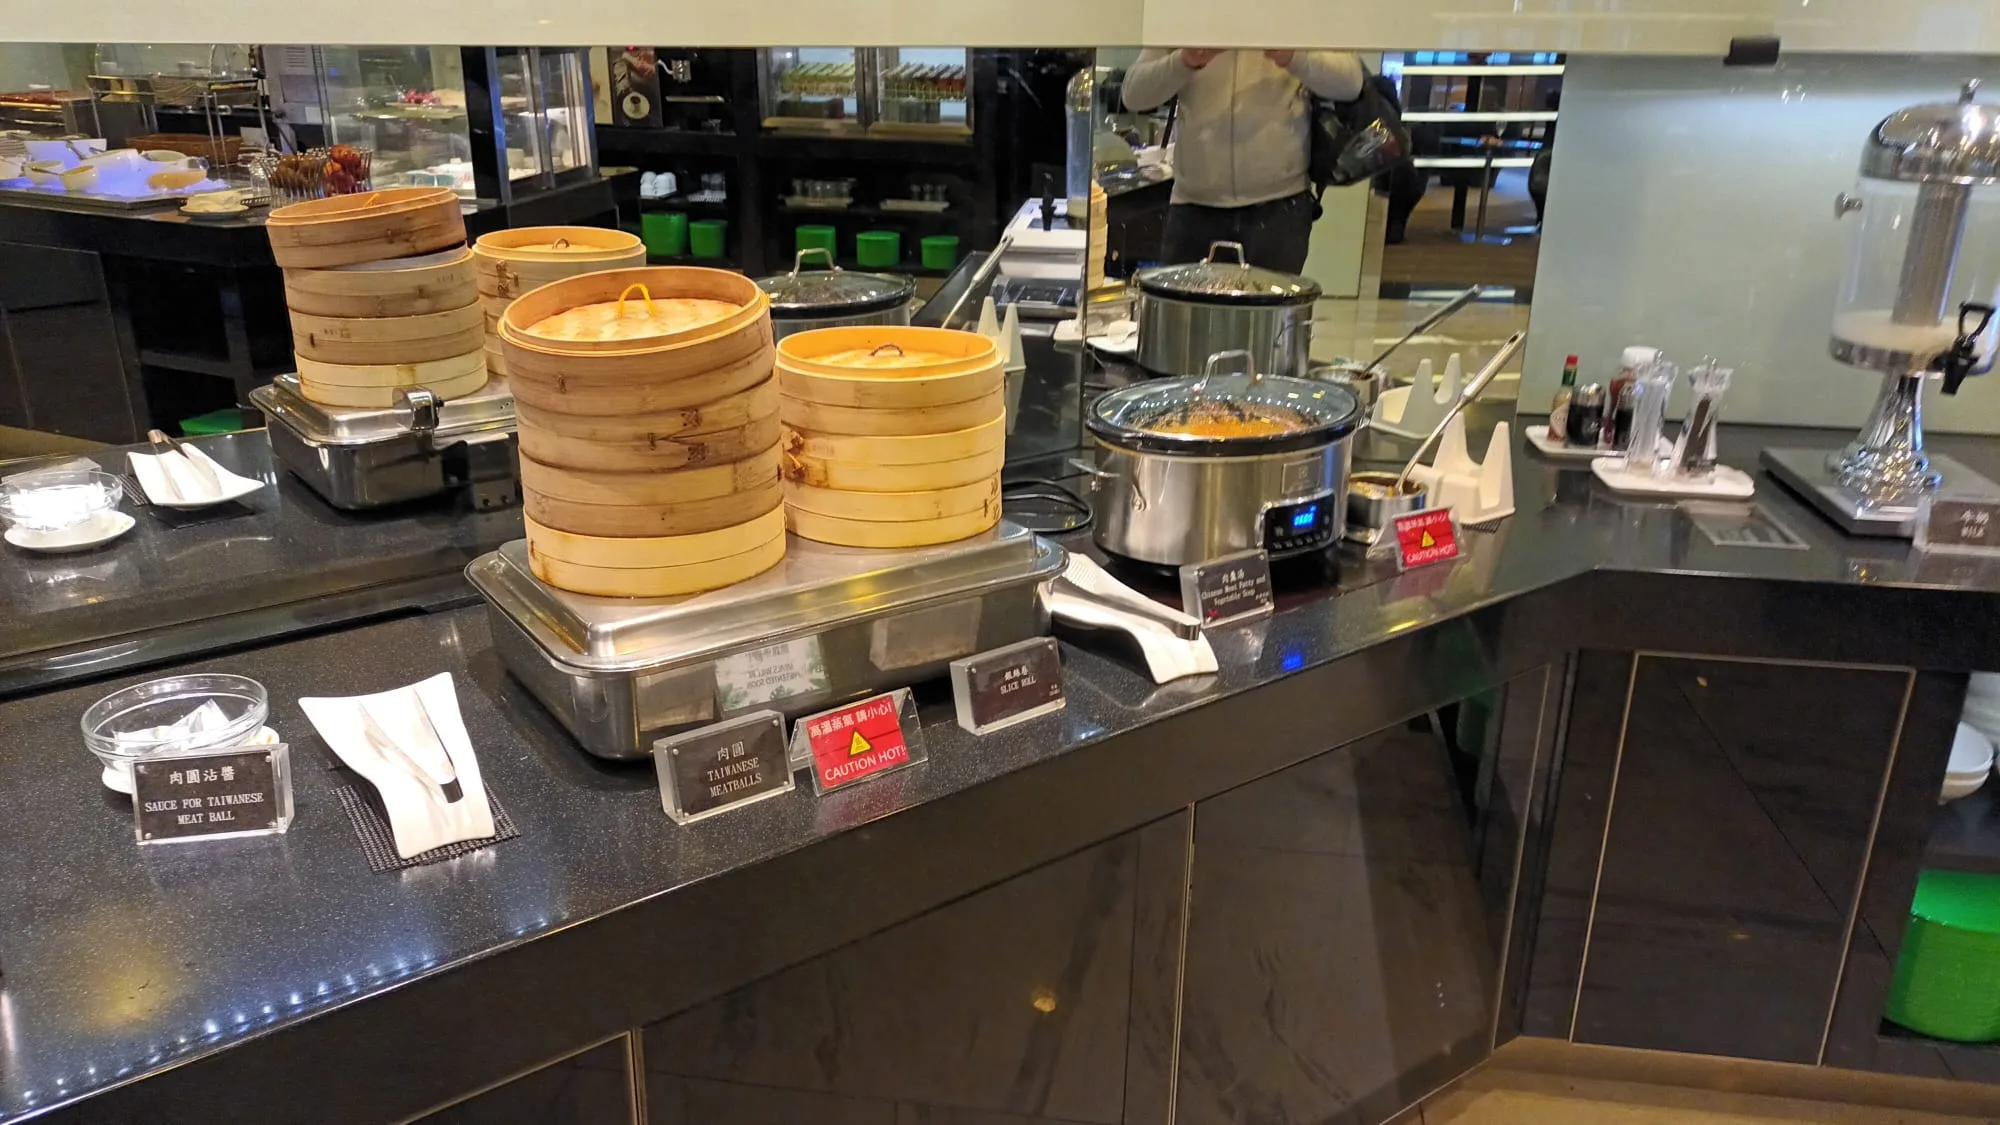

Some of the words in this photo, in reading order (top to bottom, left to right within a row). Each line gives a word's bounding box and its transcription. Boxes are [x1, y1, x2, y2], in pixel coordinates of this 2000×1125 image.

[707, 757, 760, 782] TAIWANESE
[824, 755, 877, 782] CAUTION
[877, 744, 907, 765] HOT!
[709, 773, 762, 798] MEATBALLS
[144, 800, 177, 813] SAUCE
[183, 798, 202, 809] FOR
[207, 792, 264, 807] TAIWANESE
[177, 813, 204, 825] MEAT
[209, 811, 235, 822] BALL
